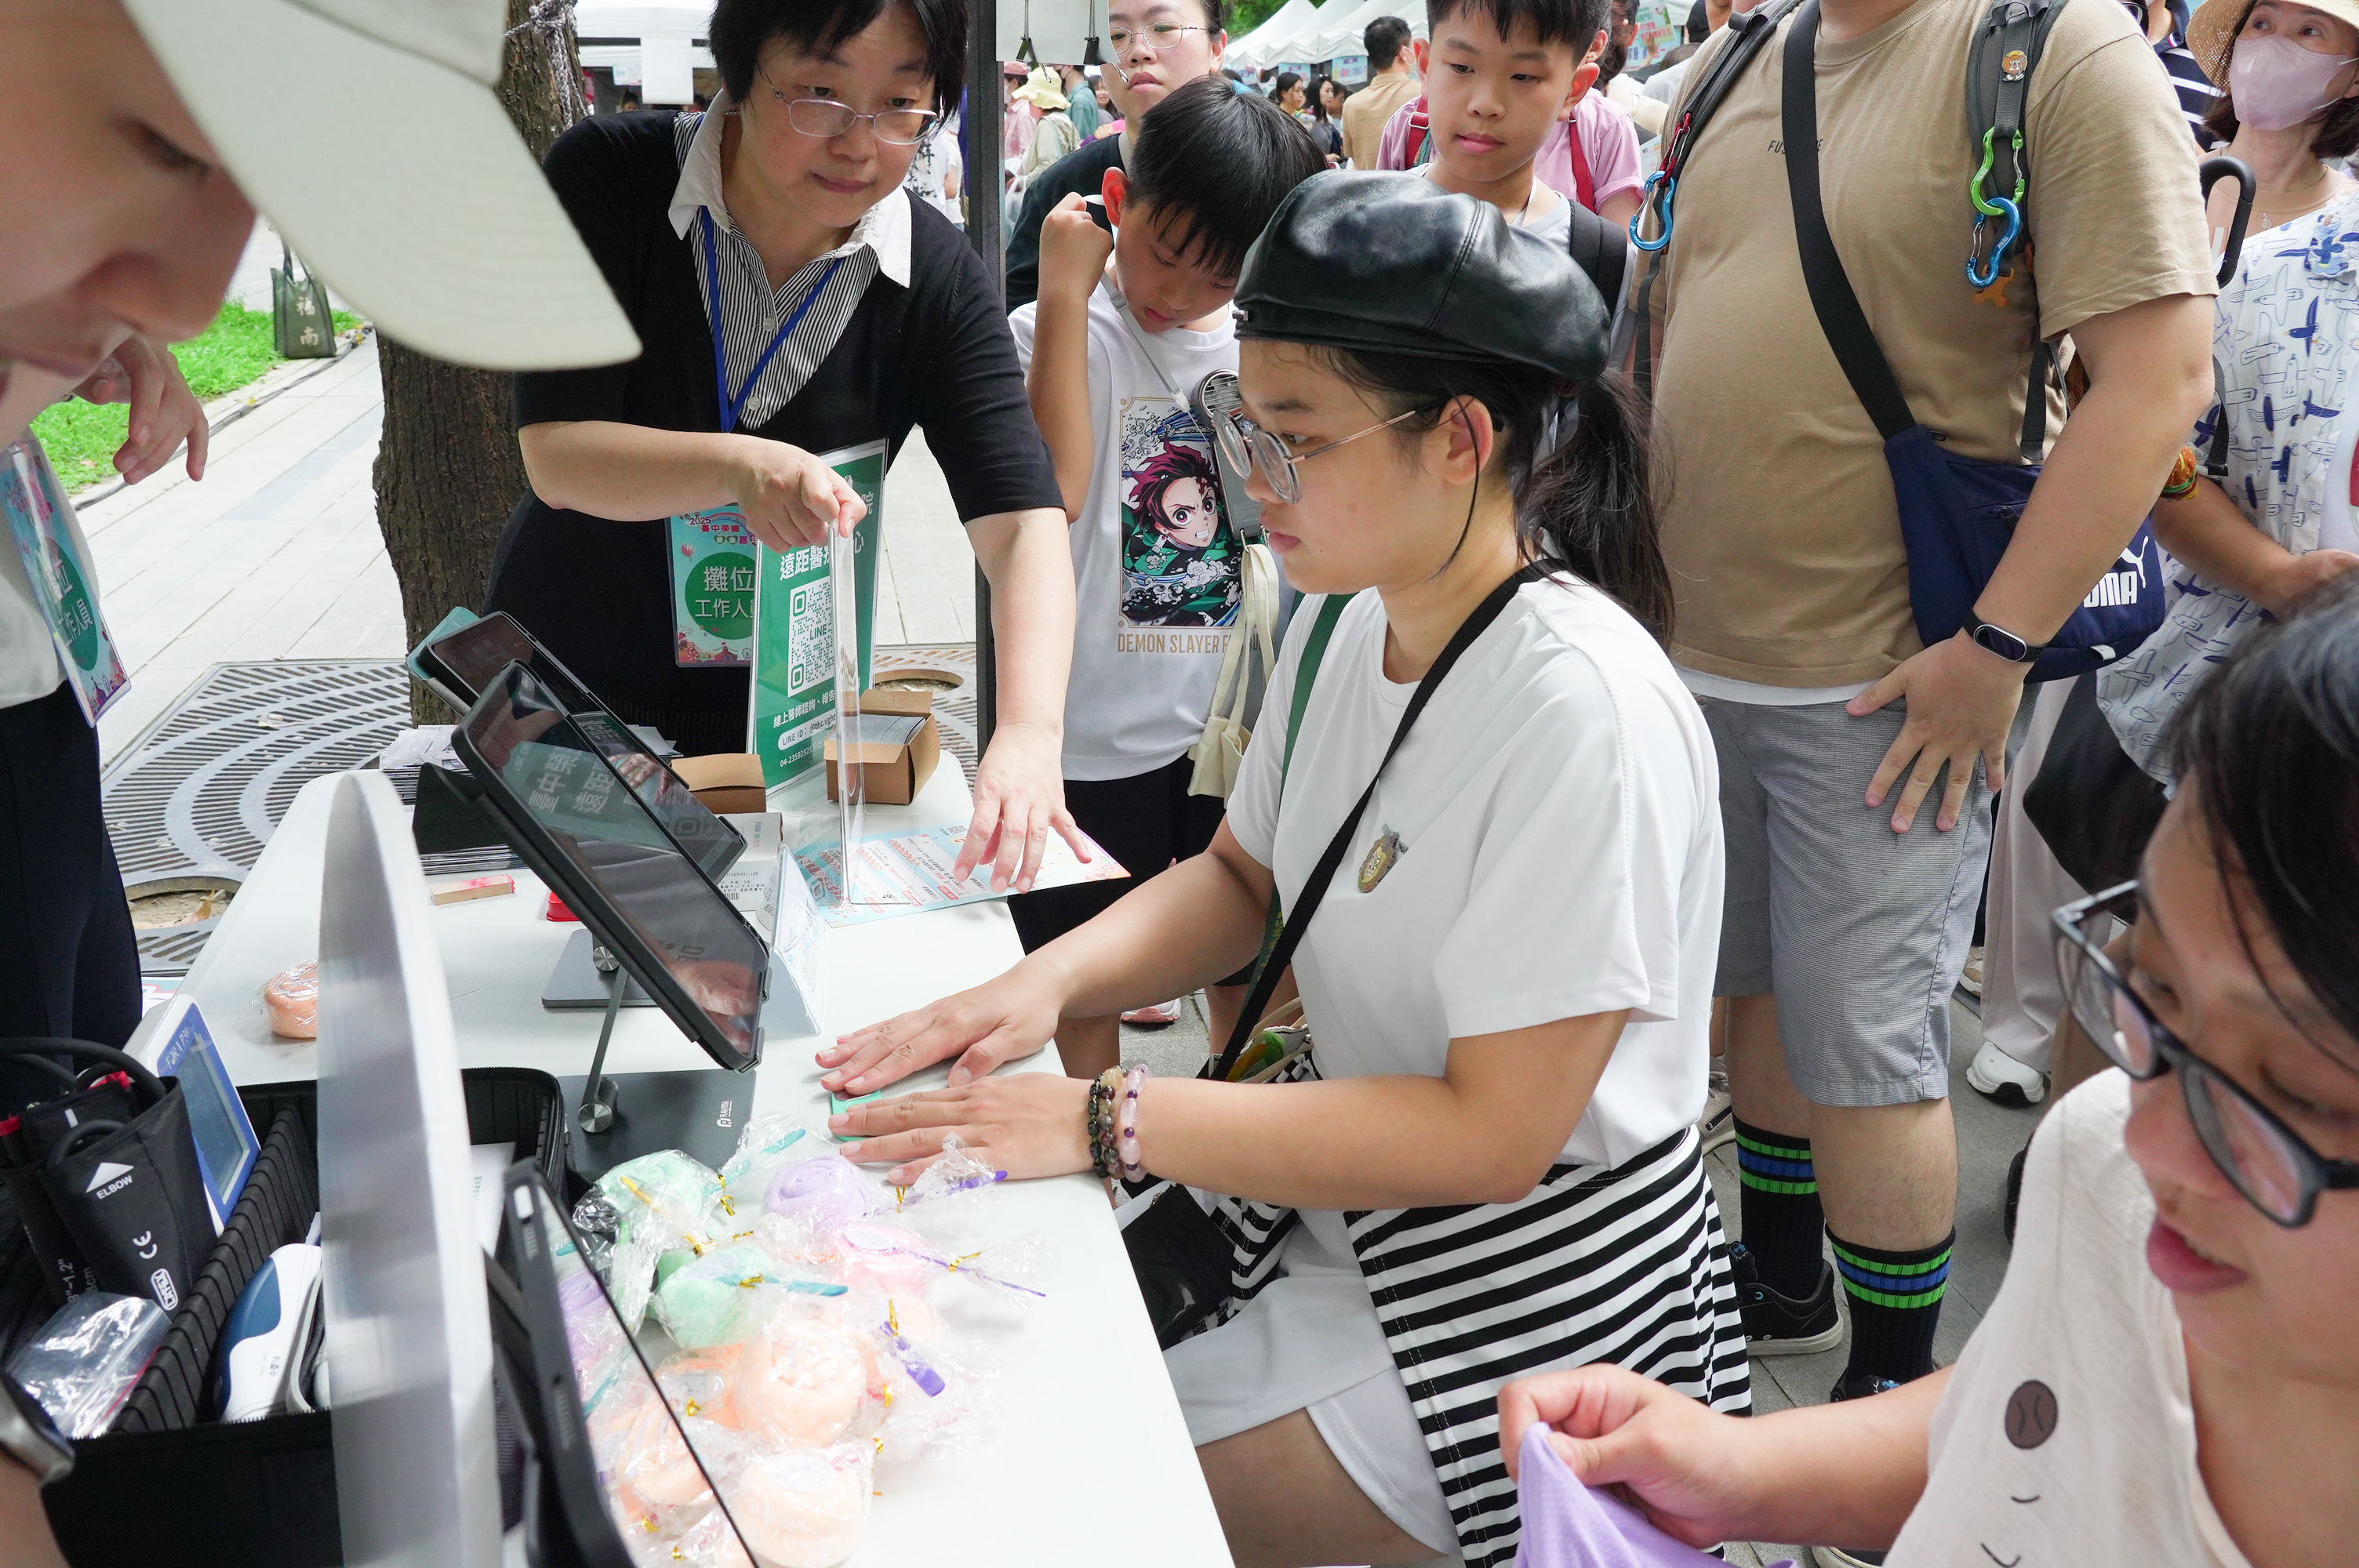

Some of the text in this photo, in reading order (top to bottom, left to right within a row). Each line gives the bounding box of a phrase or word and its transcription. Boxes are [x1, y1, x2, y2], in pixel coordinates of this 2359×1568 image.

[703, 566, 755, 592] 攤位
[2084, 571, 2138, 608] UMA
[809, 624, 827, 641] LINE
[1118, 633, 1165, 652] DEMON
[1169, 634, 1219, 653] SLAYER
[783, 733, 795, 746] LINE
[96, 1174, 133, 1200] ELBOW
